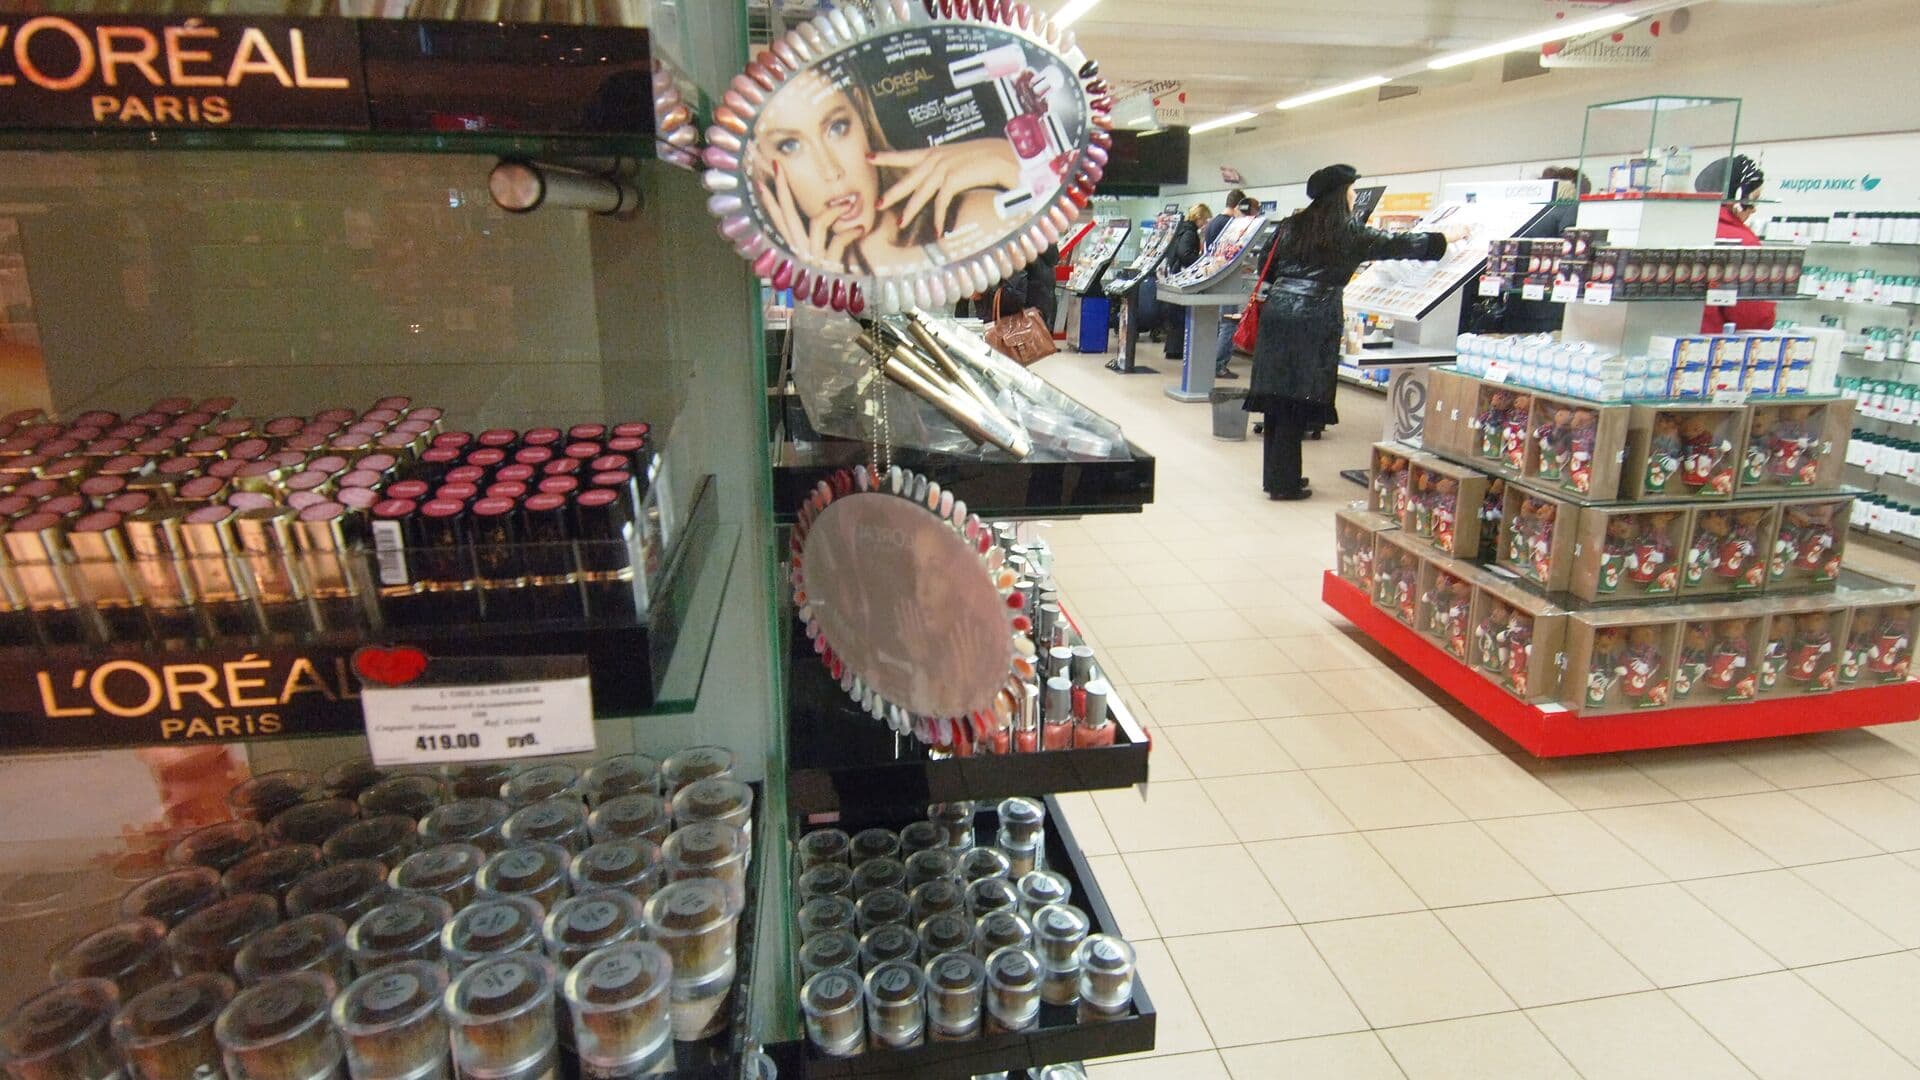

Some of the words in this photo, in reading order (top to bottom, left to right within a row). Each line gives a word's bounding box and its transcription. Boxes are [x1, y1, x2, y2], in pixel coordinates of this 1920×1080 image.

[0, 16, 349, 91] 'ORÉAL
[91, 95, 232, 123] PARIS
[160, 712, 282, 739] PARIS
[416, 733, 480, 751] 419.00
